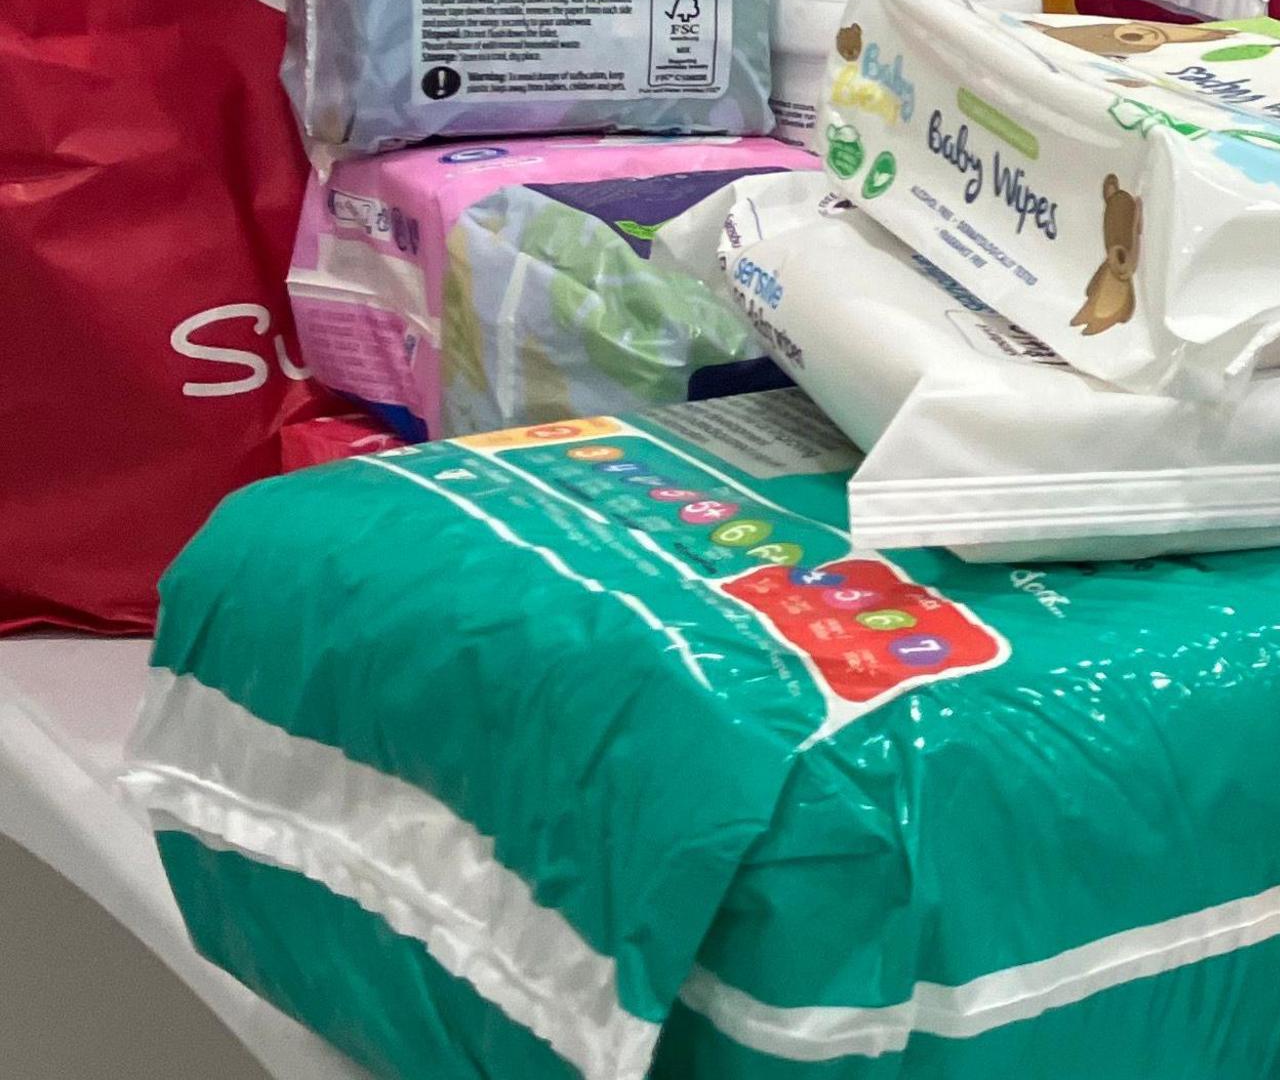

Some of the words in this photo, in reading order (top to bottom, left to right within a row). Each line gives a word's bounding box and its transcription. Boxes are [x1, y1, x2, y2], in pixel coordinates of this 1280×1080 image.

[671, 24, 700, 35] FSC
[1165, 65, 1267, 104] Wipes
[927, 109, 984, 204] Baby
[993, 151, 1058, 240] Wipes
